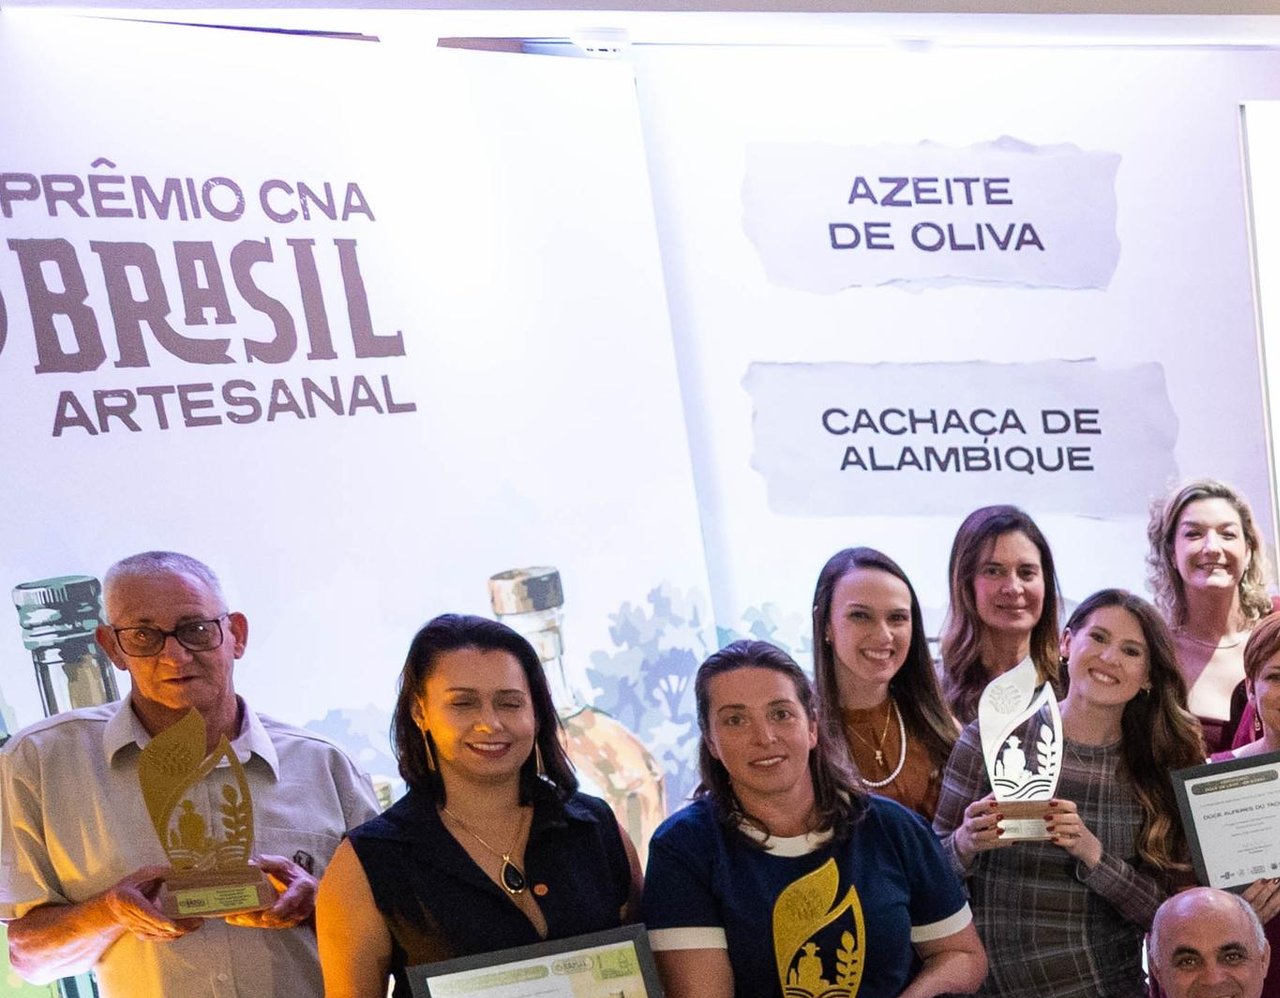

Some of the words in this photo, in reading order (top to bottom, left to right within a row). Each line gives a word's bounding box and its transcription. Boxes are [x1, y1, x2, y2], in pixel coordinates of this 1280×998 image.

[0, 157, 245, 222] PRÊMIO
[258, 178, 376, 223] CNA
[847, 176, 1014, 207] AZEITE
[828, 222, 895, 250] DE
[910, 221, 1045, 252] OLIVA
[8, 237, 406, 374] BRASIL
[51, 374, 418, 438] ARTESANAL
[821, 408, 1026, 443] CACHAÇA
[1041, 408, 1102, 435] DE
[840, 445, 1094, 475] ALAMBIQUE
